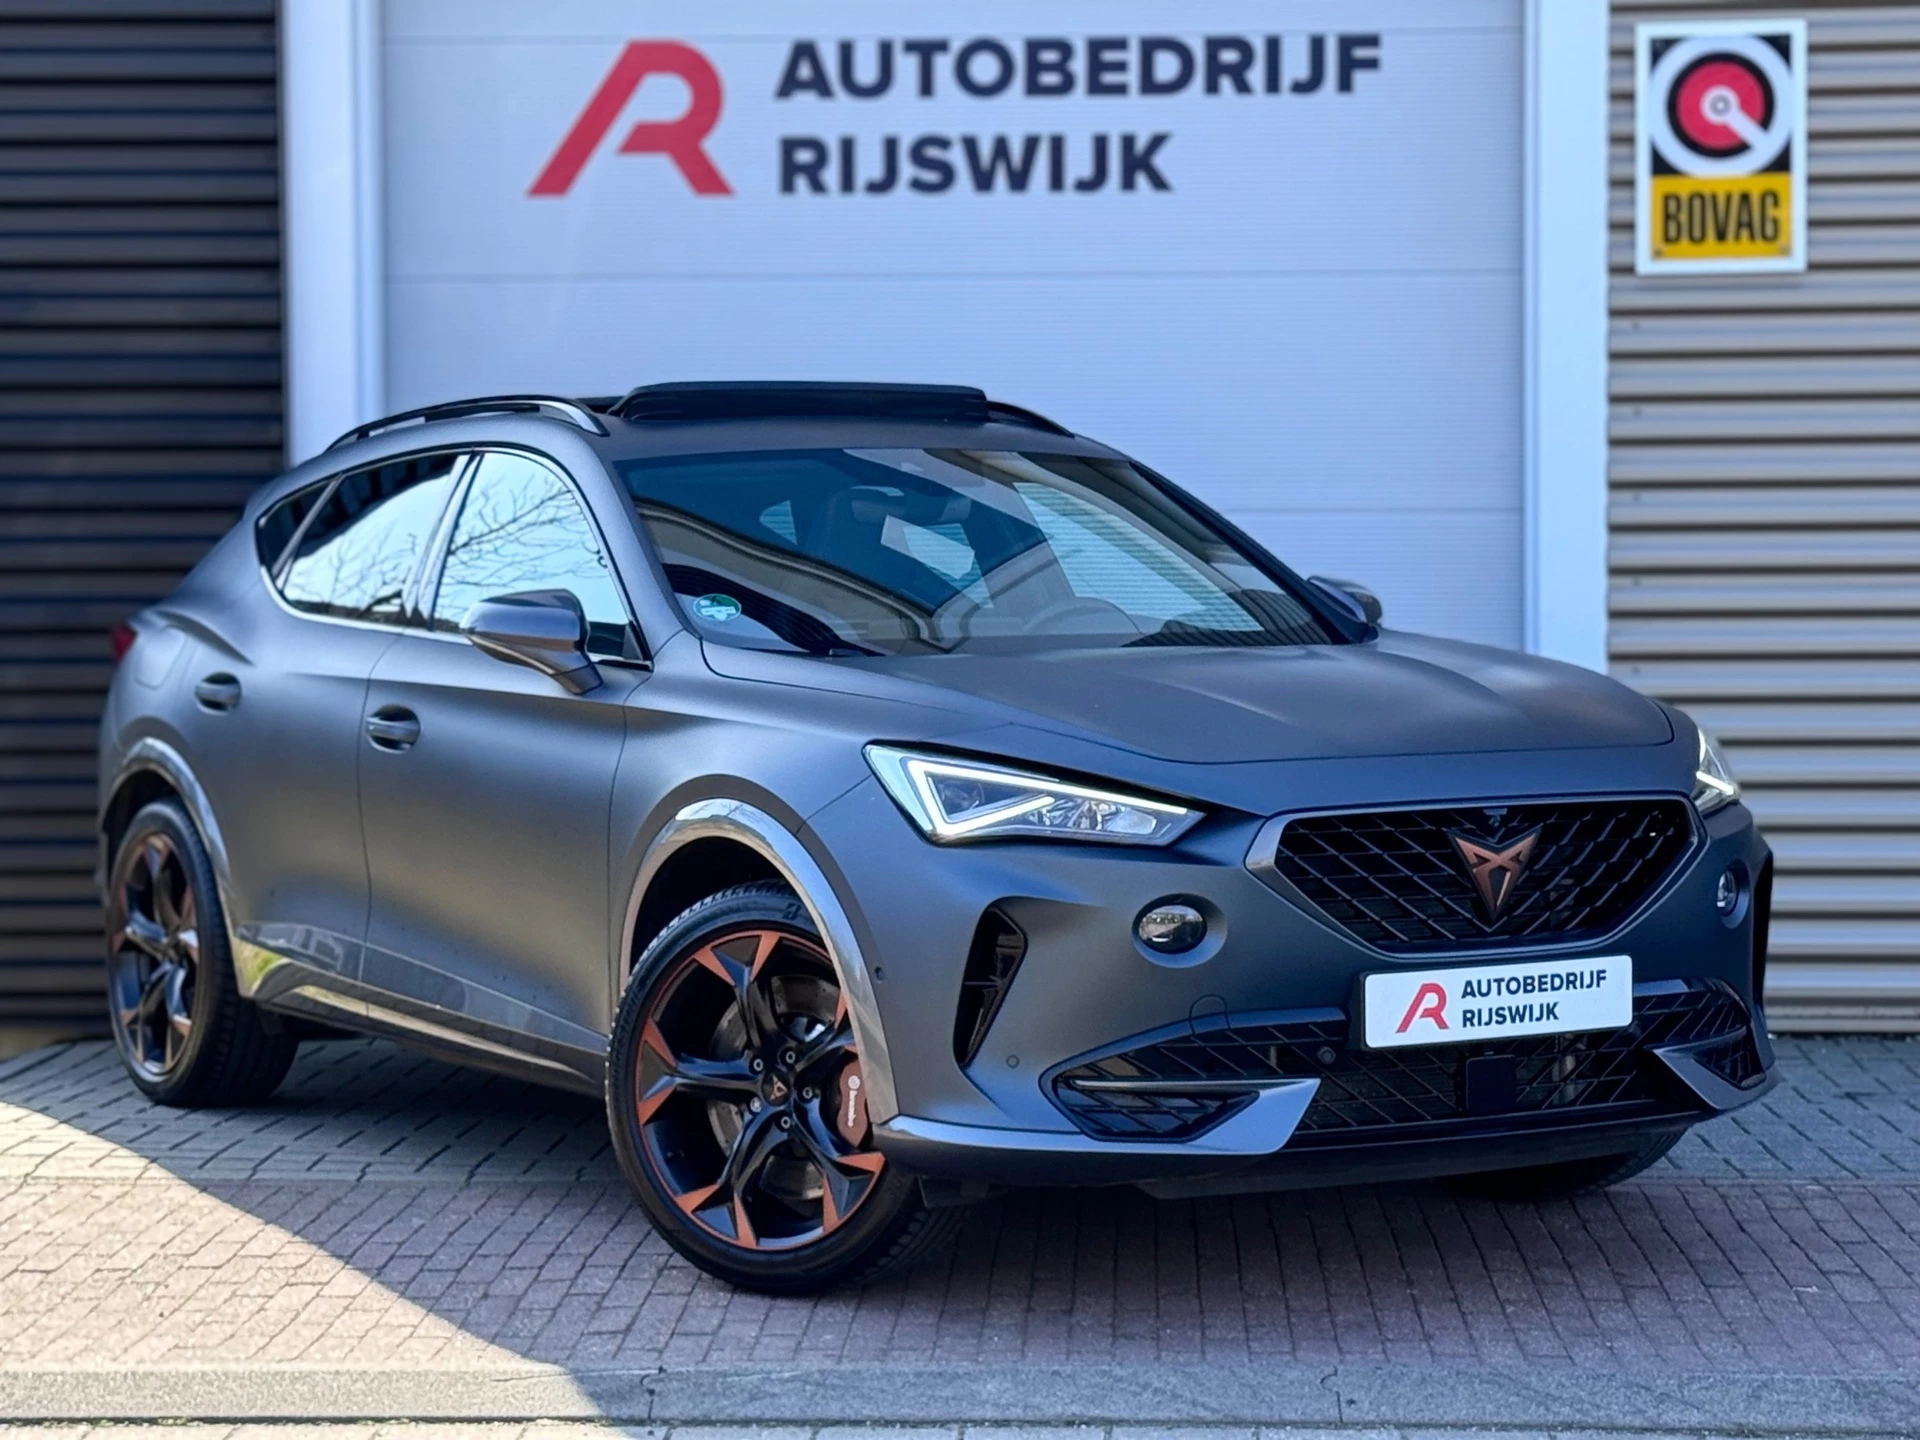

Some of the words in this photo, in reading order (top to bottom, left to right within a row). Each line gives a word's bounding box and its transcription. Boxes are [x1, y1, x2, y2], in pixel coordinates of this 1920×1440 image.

[776, 34, 1381, 98] AUTOBEDRIJF
[779, 134, 1172, 195] RIJSWIJK
[1662, 190, 1780, 244] BOVAG
[1460, 969, 1607, 999] AUTOBEDRIJF
[1461, 1002, 1559, 1028] RIJSWIJK
